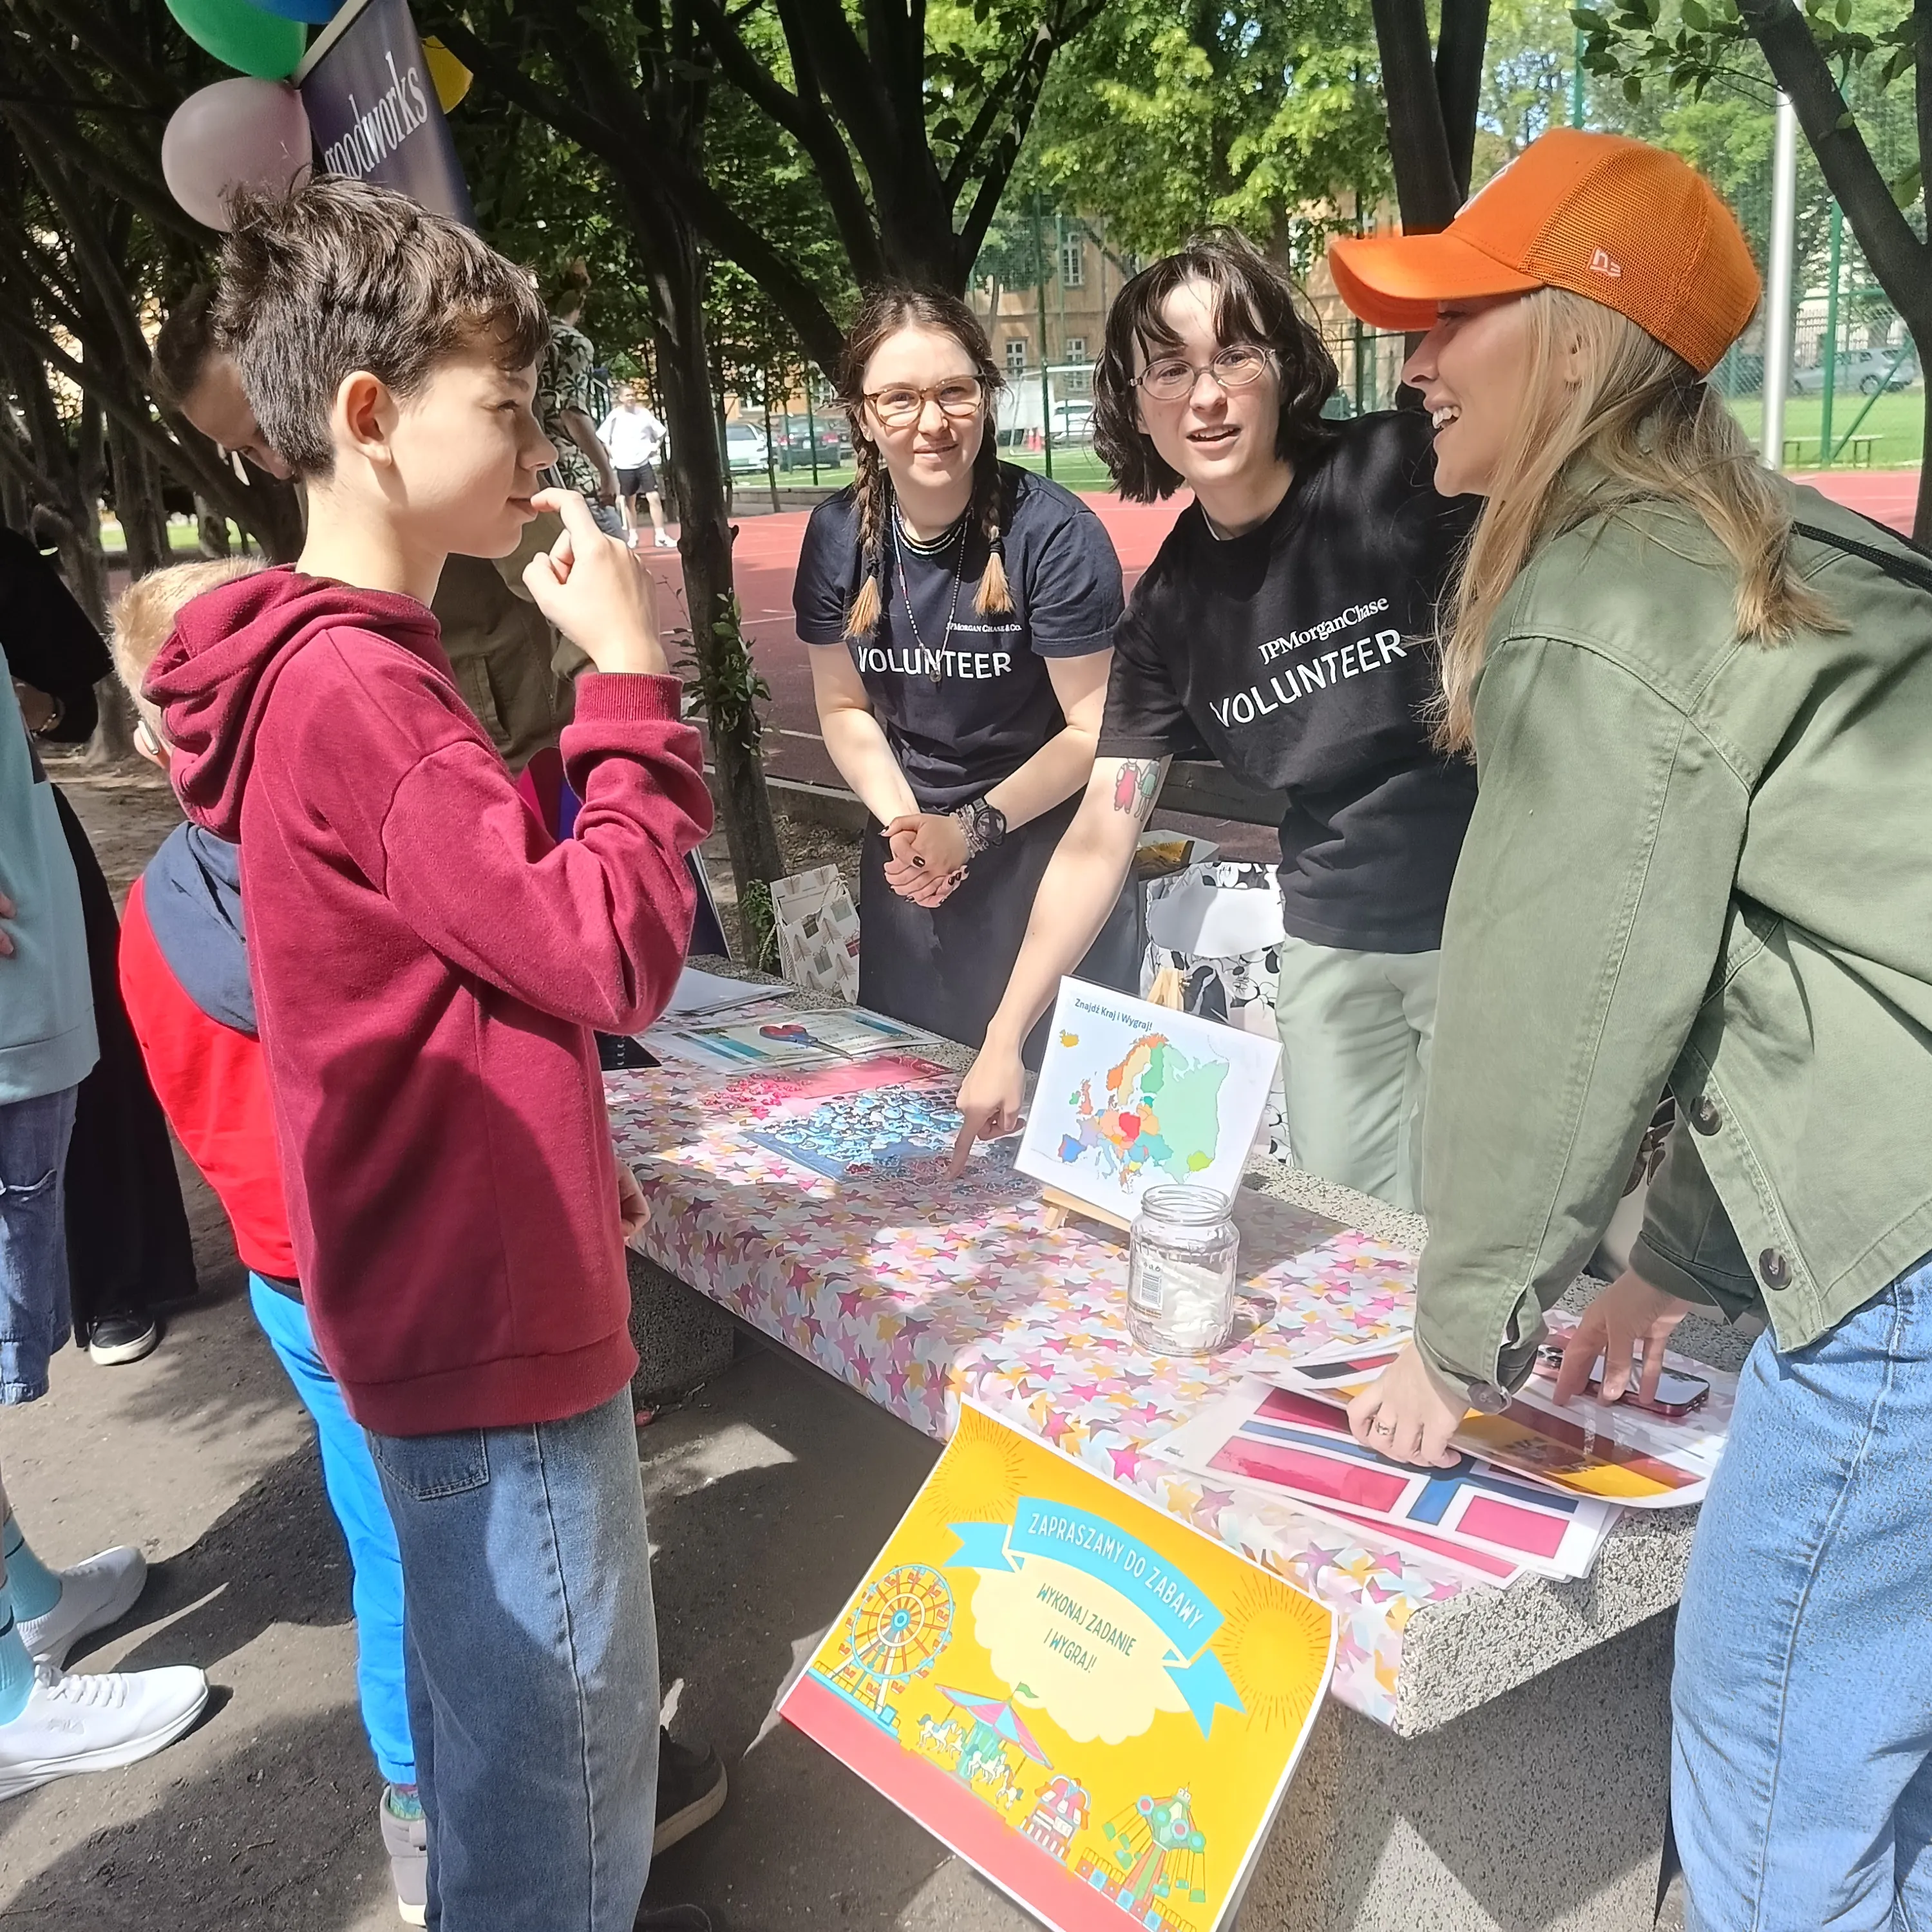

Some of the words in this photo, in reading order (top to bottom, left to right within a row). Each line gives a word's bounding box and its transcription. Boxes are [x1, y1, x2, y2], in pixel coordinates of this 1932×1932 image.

[858, 645, 1012, 679] VOLUNTEER
[1258, 597, 1389, 665] JPMorganChase
[1209, 629, 1407, 728] VOLUNTEER
[1074, 998, 1100, 1014] Znajdź
[1101, 1006, 1117, 1021] Kraj
[1117, 1012, 1121, 1021] i
[1121, 1012, 1153, 1032] Wygraj!
[1028, 1513, 1125, 1564] ZAPRASZAMY
[1123, 1548, 1146, 1578] DO
[1144, 1566, 1204, 1629] ZABAWY
[1036, 1582, 1089, 1626] WYKONAJ
[1085, 1613, 1137, 1657] ZADANIE
[1043, 1628, 1054, 1644] I
[1049, 1631, 1097, 1674] WYGRAJ!
